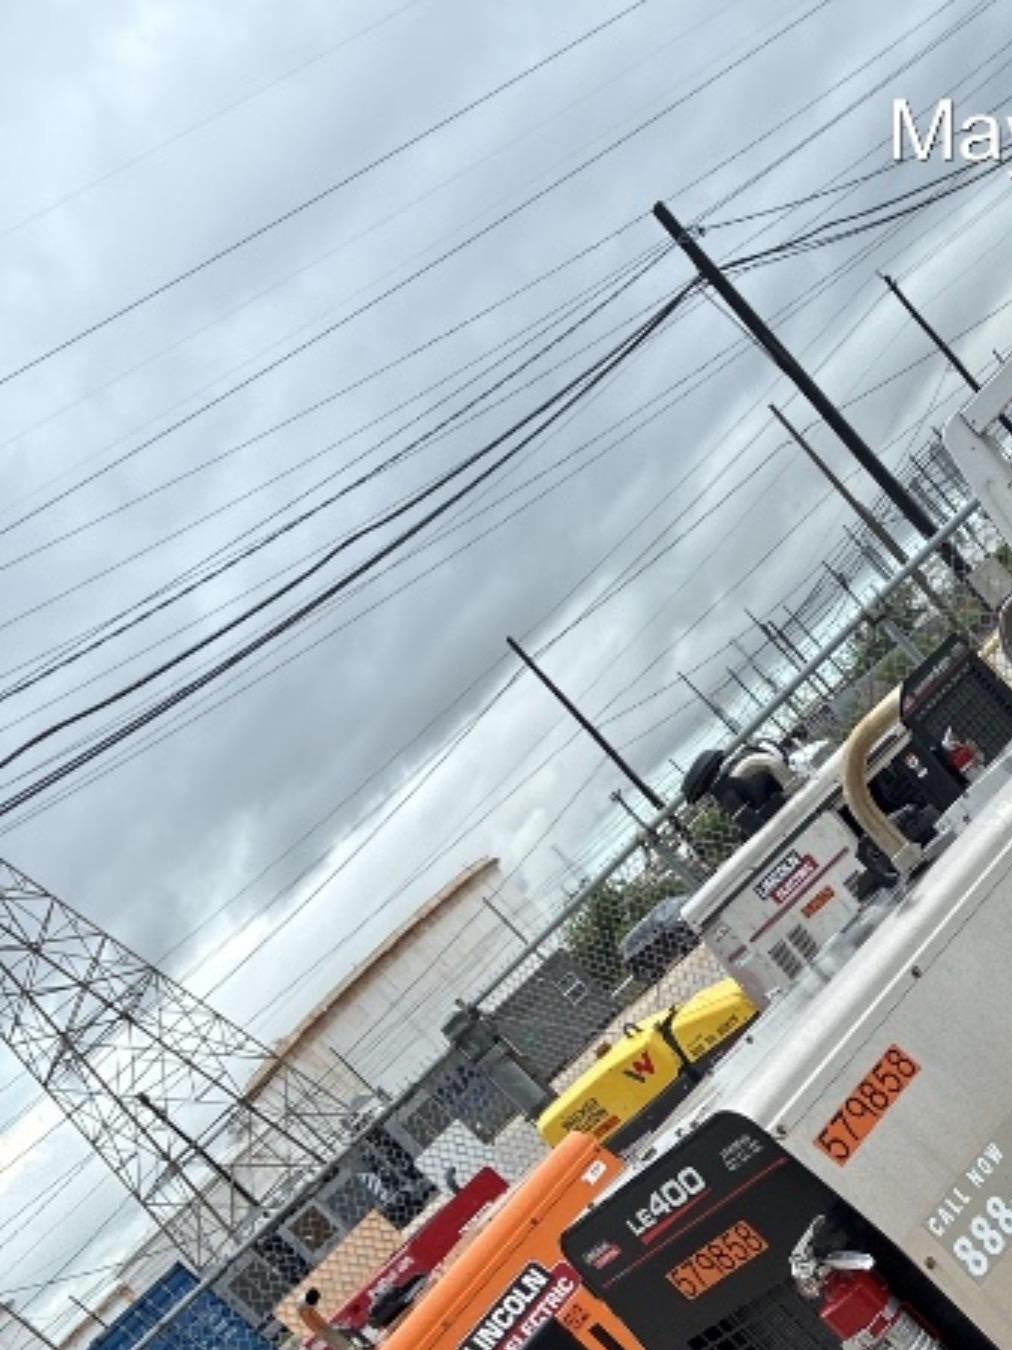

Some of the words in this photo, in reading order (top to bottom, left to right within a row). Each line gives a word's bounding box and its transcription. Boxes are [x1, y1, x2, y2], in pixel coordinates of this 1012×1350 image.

[820, 1048, 920, 1164] 579858
[926, 1188, 973, 1239] CALL
[964, 1140, 1006, 1188] NOW
[668, 1222, 767, 1300] 579858
